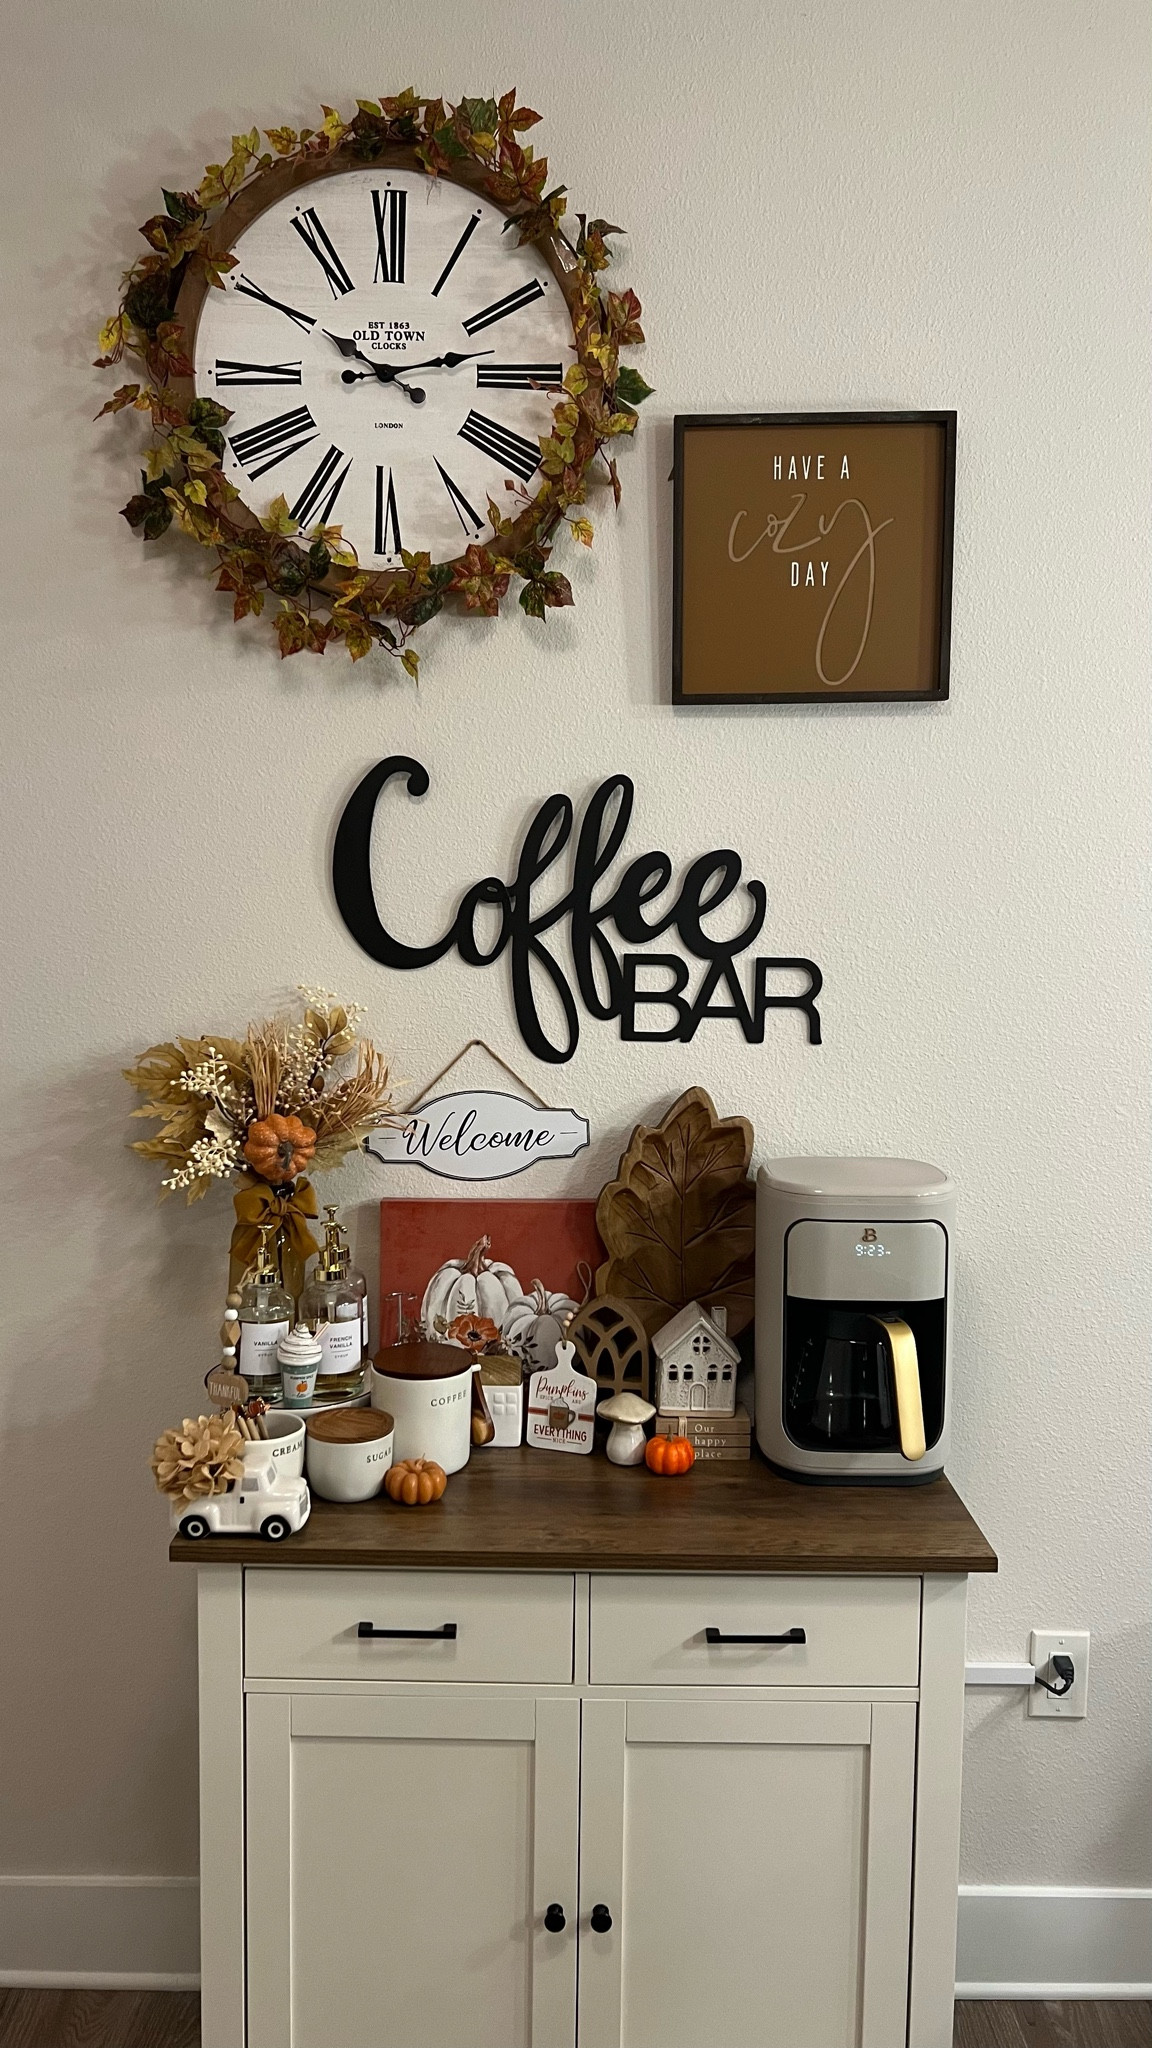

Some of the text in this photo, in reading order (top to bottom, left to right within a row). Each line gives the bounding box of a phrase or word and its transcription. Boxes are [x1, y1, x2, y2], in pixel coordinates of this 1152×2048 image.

[371, 190, 408, 283] XII
[290, 207, 355, 300] XI
[431, 214, 481, 297] I
[233, 273, 317, 334] X
[461, 278, 545, 337] II
[352, 330, 425, 341] OLD TOWN
[389, 322, 410, 330] 1863
[371, 342, 407, 350] CLOCKS
[215, 359, 302, 386] IX
[476, 362, 563, 391] III
[228, 405, 321, 482] VIII
[773, 454, 850, 481] HAVE A
[432, 455, 486, 536] V
[374, 465, 402, 555] VI
[791, 561, 829, 587] DAY
[728, 492, 894, 686] cozy
[332, 755, 766, 1064] Coffee
[620, 953, 823, 1045] BAR
[401, 1108, 555, 1158] Welcome
[855, 1244, 884, 1257] 9:23
[209, 1381, 240, 1401] THANKFUL
[430, 1389, 467, 1408] COFFEE
[536, 1375, 589, 1400] Pumpkins
[534, 1424, 587, 1442] EVERYTHING
[694, 1423, 715, 1433] Our
[694, 1436, 727, 1447] happy
[272, 1441, 303, 1458] CREAM
[366, 1447, 392, 1464] SUGAR
[694, 1449, 722, 1460] place
